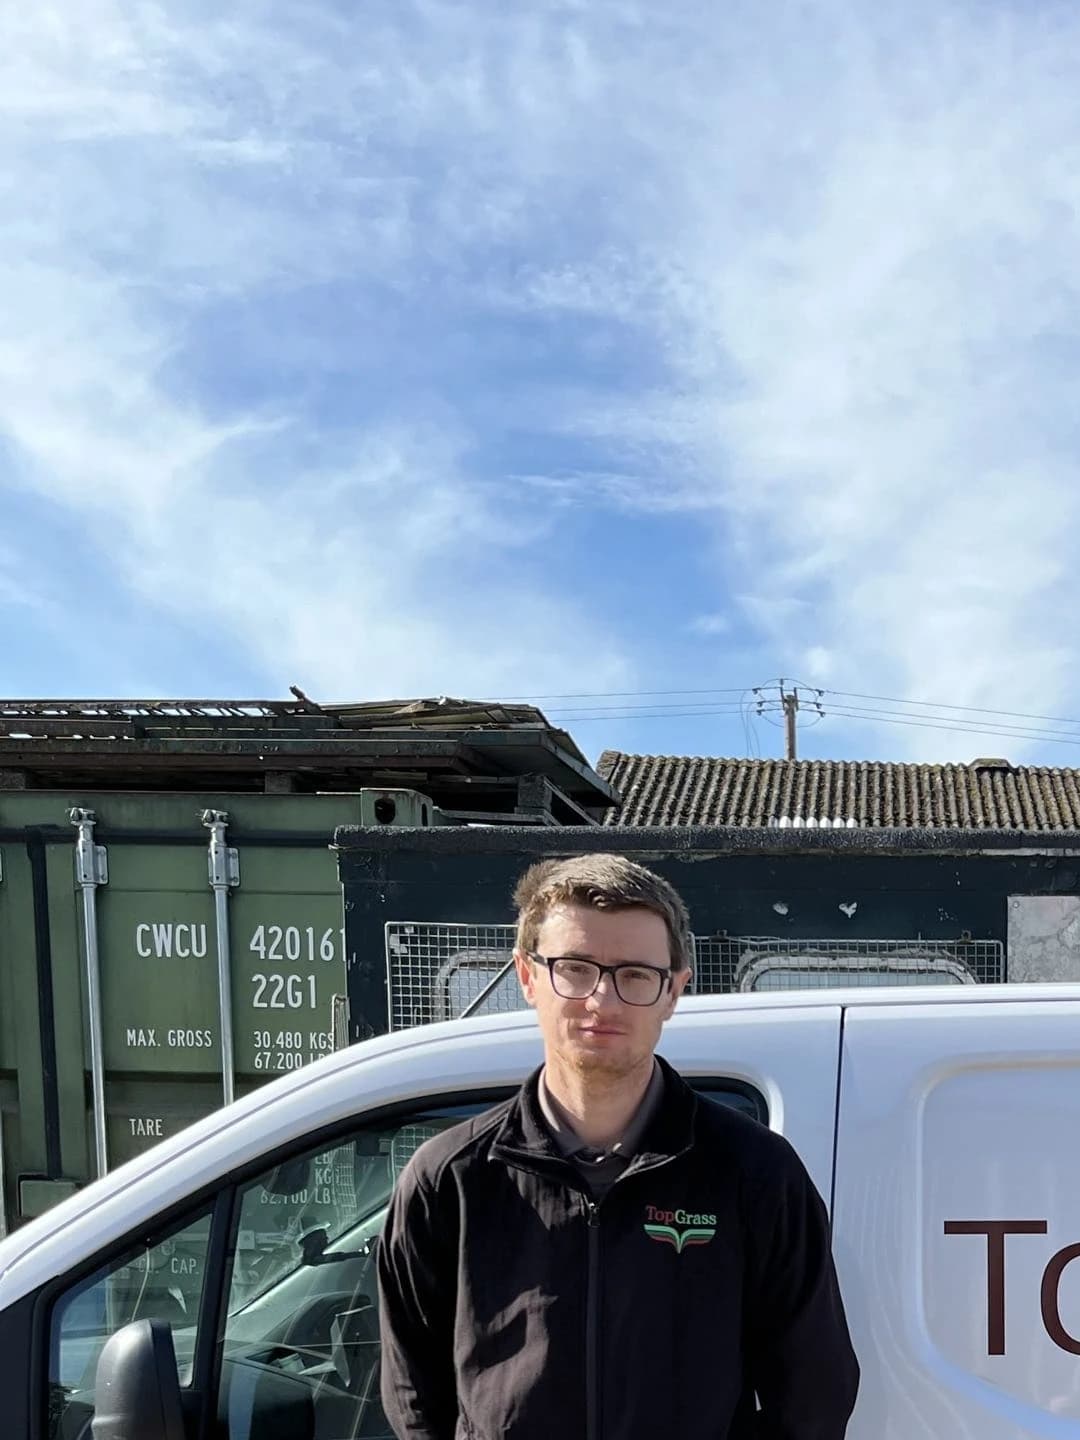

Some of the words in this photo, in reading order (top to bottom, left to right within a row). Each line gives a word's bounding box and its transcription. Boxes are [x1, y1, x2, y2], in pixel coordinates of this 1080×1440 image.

[136, 924, 207, 958] CWCU
[252, 974, 316, 1009] 22G1
[127, 1029, 161, 1047] MAX.
[168, 1030, 212, 1047] GROSS
[253, 1031, 302, 1049] 30.480
[254, 1052, 303, 1070] 67.200
[129, 1119, 163, 1136] TARE
[645, 1204, 717, 1225] TopGrass
